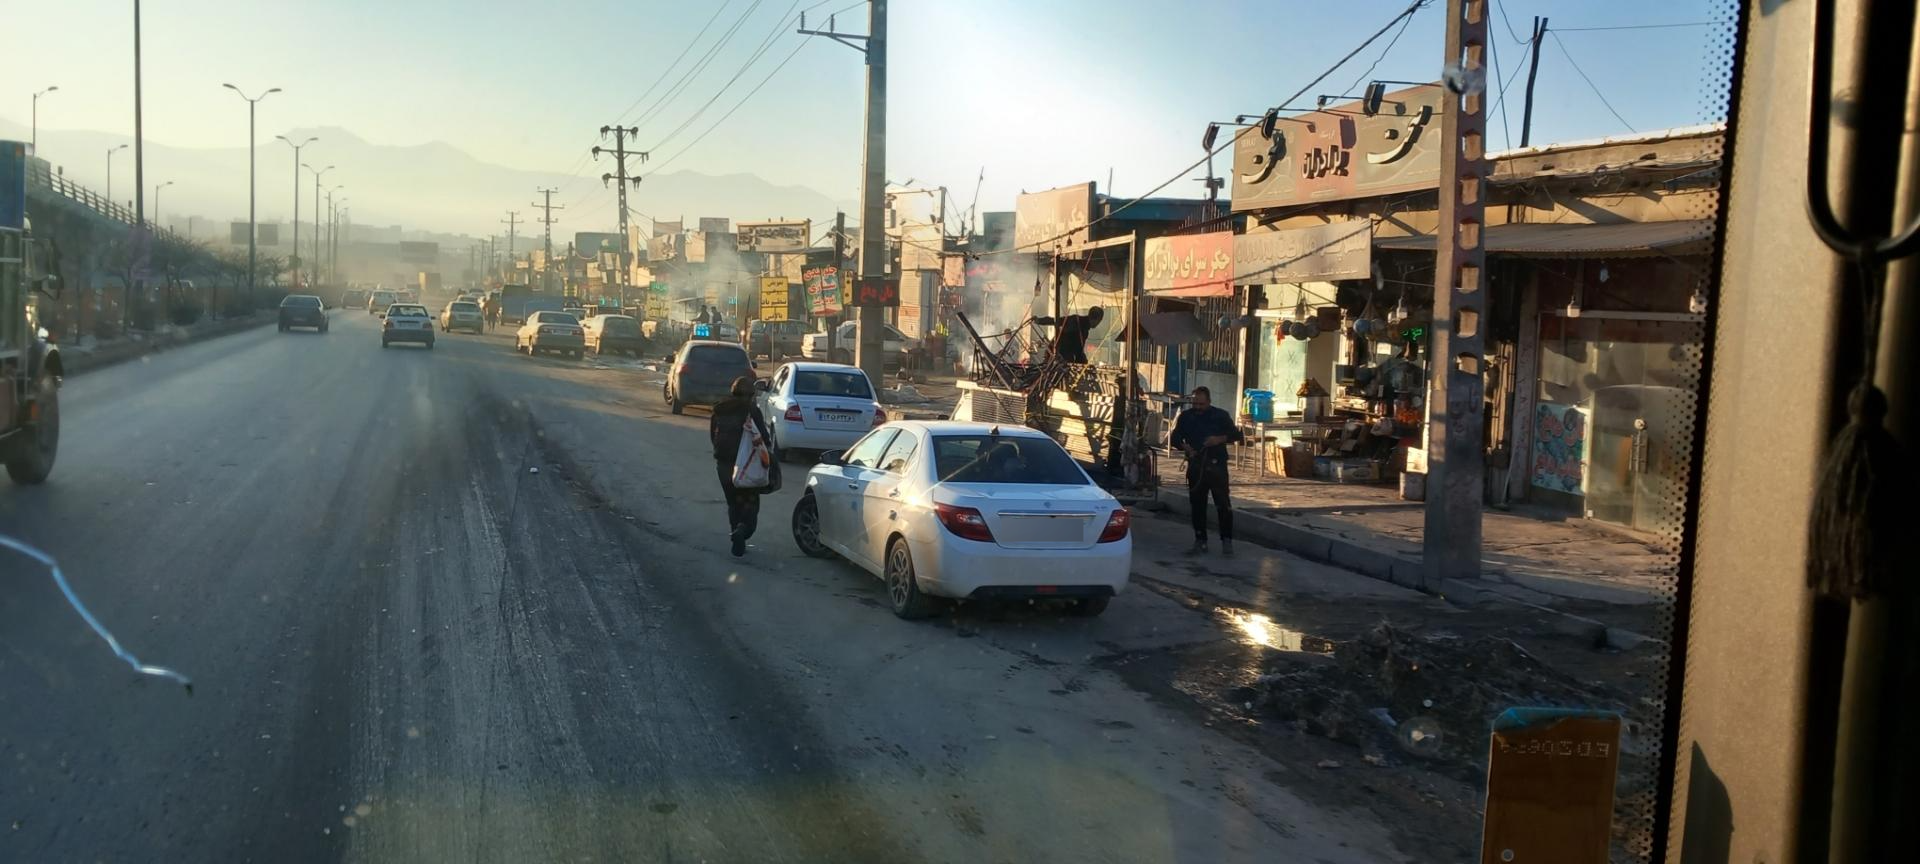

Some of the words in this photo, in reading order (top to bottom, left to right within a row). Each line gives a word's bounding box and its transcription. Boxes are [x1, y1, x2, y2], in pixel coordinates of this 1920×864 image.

[1146, 243, 1180, 279] برادران
[1180, 247, 1208, 279] سرای
[1208, 246, 1231, 279] جگر
